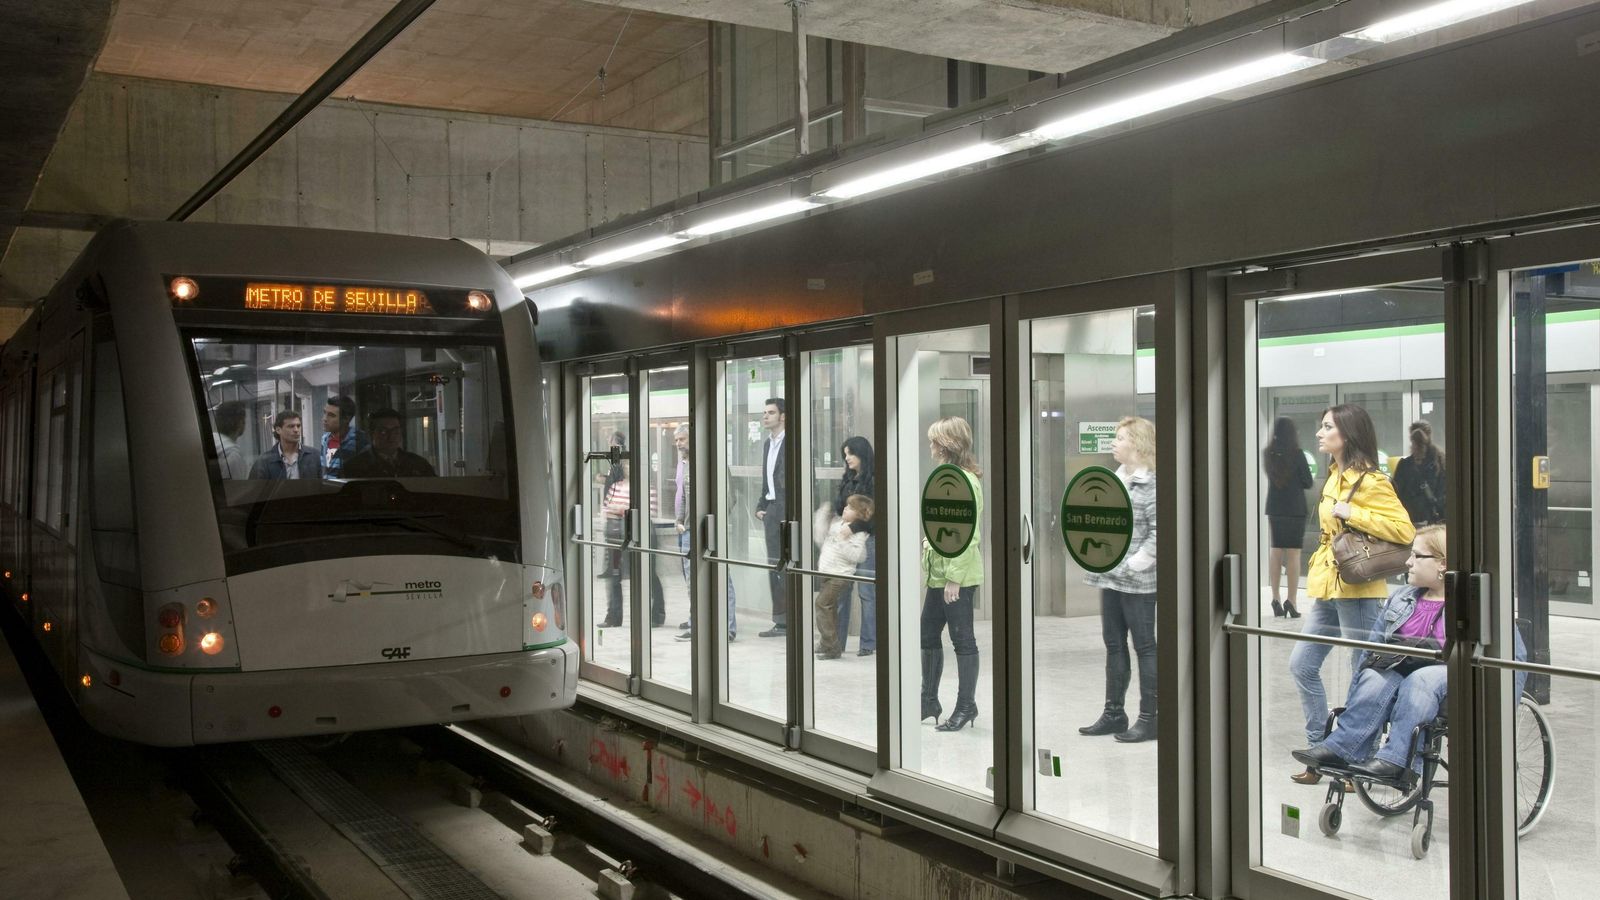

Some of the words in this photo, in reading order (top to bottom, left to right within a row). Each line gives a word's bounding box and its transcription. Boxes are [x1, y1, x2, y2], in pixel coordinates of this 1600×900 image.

[249, 288, 303, 303] METRO
[313, 290, 335, 305] DE
[345, 291, 417, 308] SEVILLA
[926, 505, 938, 515] San
[940, 506, 972, 517] Bernardo
[1066, 513, 1082, 523] San
[1085, 514, 1128, 526] Bernardo
[405, 580, 442, 589] metro
[406, 592, 443, 600] SEVILLA
[381, 647, 411, 659] CAF
